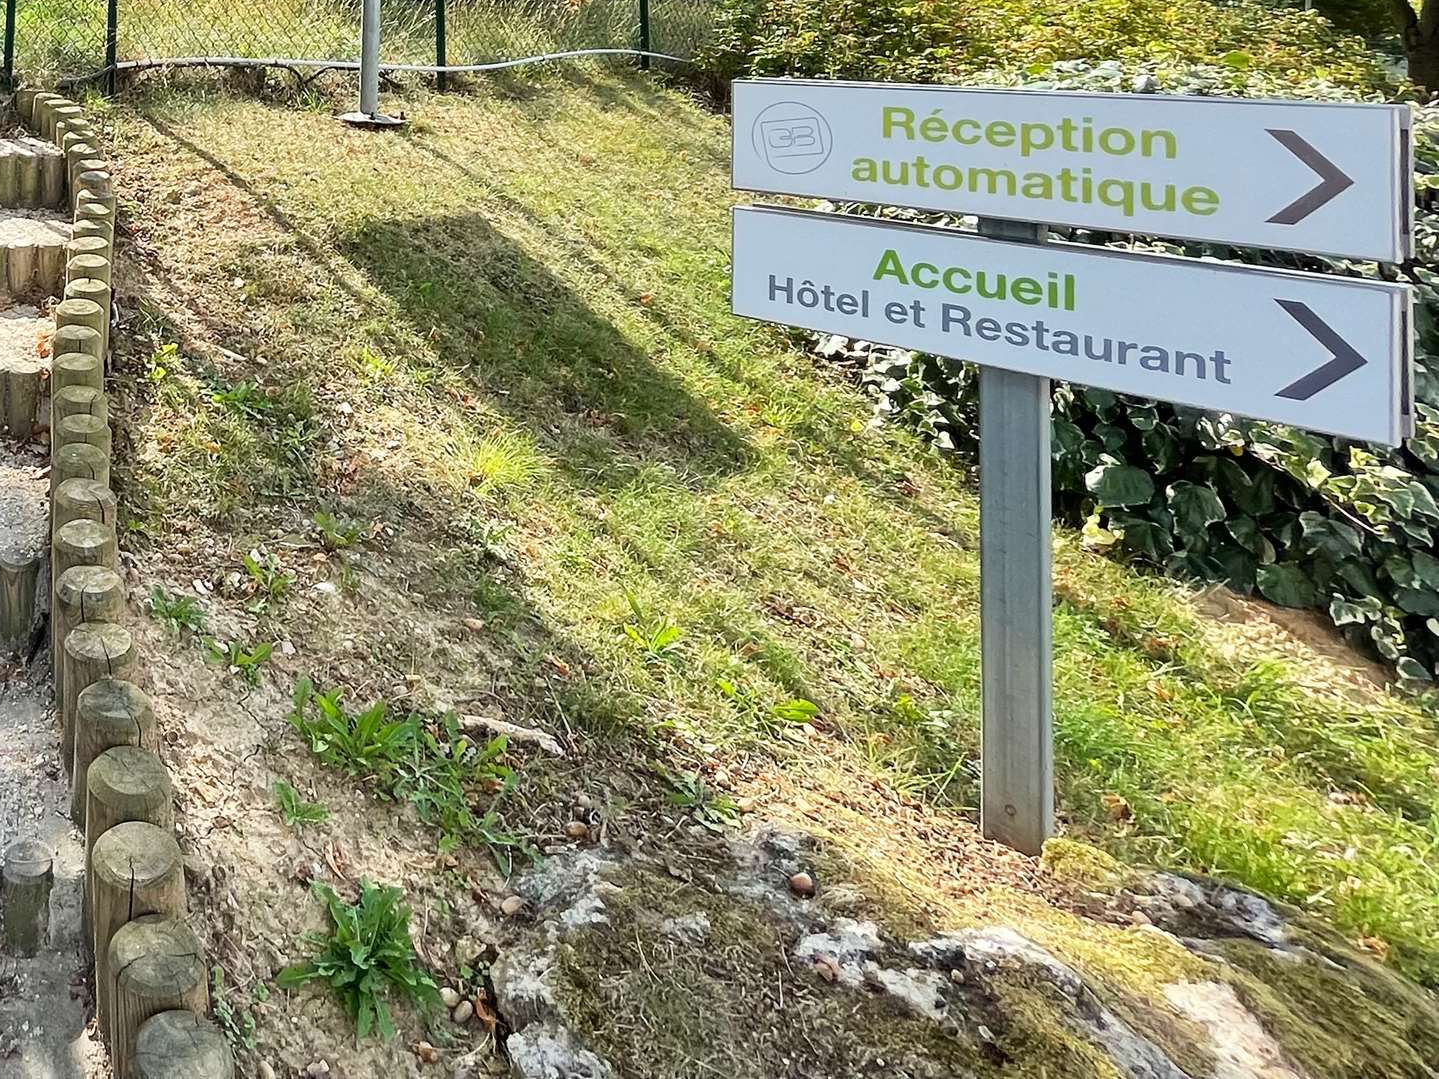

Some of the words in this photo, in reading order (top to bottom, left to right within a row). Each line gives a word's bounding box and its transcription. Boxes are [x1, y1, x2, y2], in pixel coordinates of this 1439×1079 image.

[881, 106, 1178, 159] Réception
[851, 155, 1221, 217] automatique
[872, 249, 1076, 311] Accueil
[768, 274, 869, 318] Hôtel
[884, 299, 926, 328] et
[941, 302, 1231, 384] Restaurant
